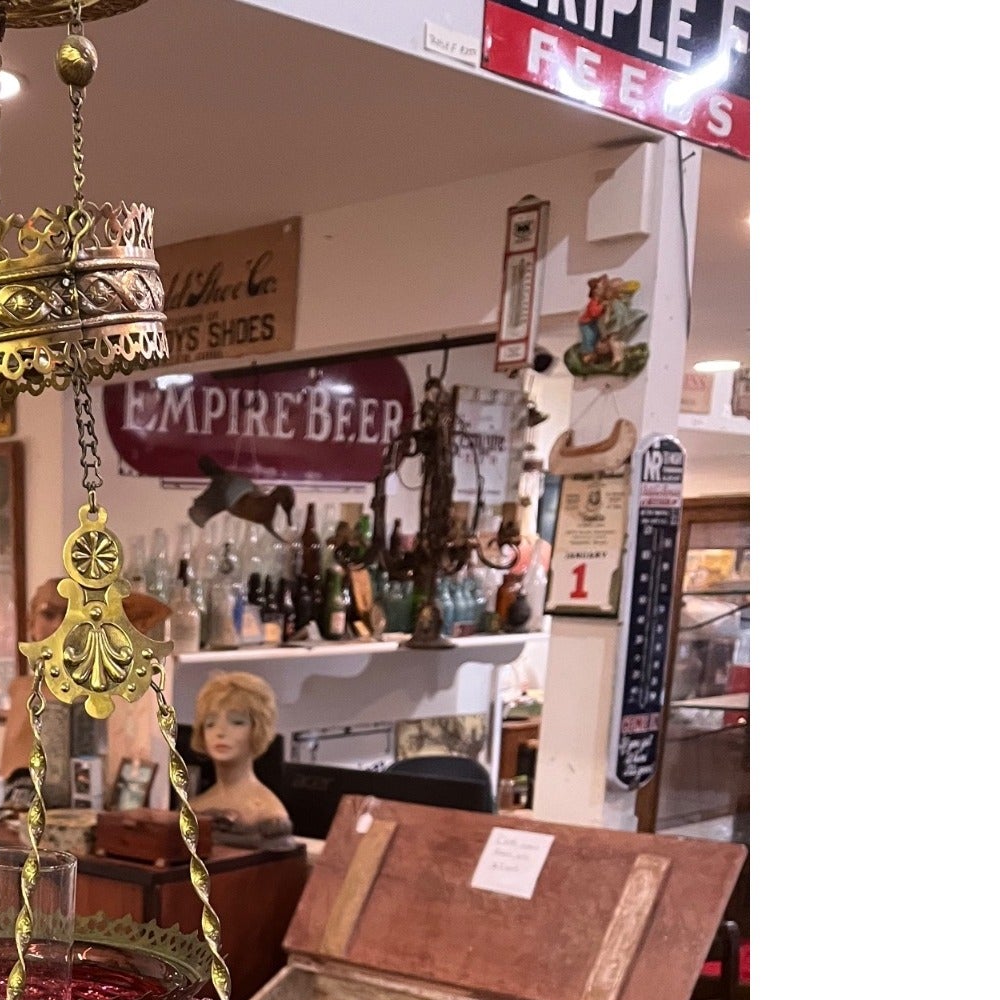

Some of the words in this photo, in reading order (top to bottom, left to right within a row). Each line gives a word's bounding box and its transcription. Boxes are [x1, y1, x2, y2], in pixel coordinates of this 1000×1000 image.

[520, 0, 697, 67] PLE
[207, 313, 275, 348] SHOES
[120, 379, 303, 439] EMPIRE
[303, 385, 403, 444] BEER
[569, 562, 588, 598] 1
